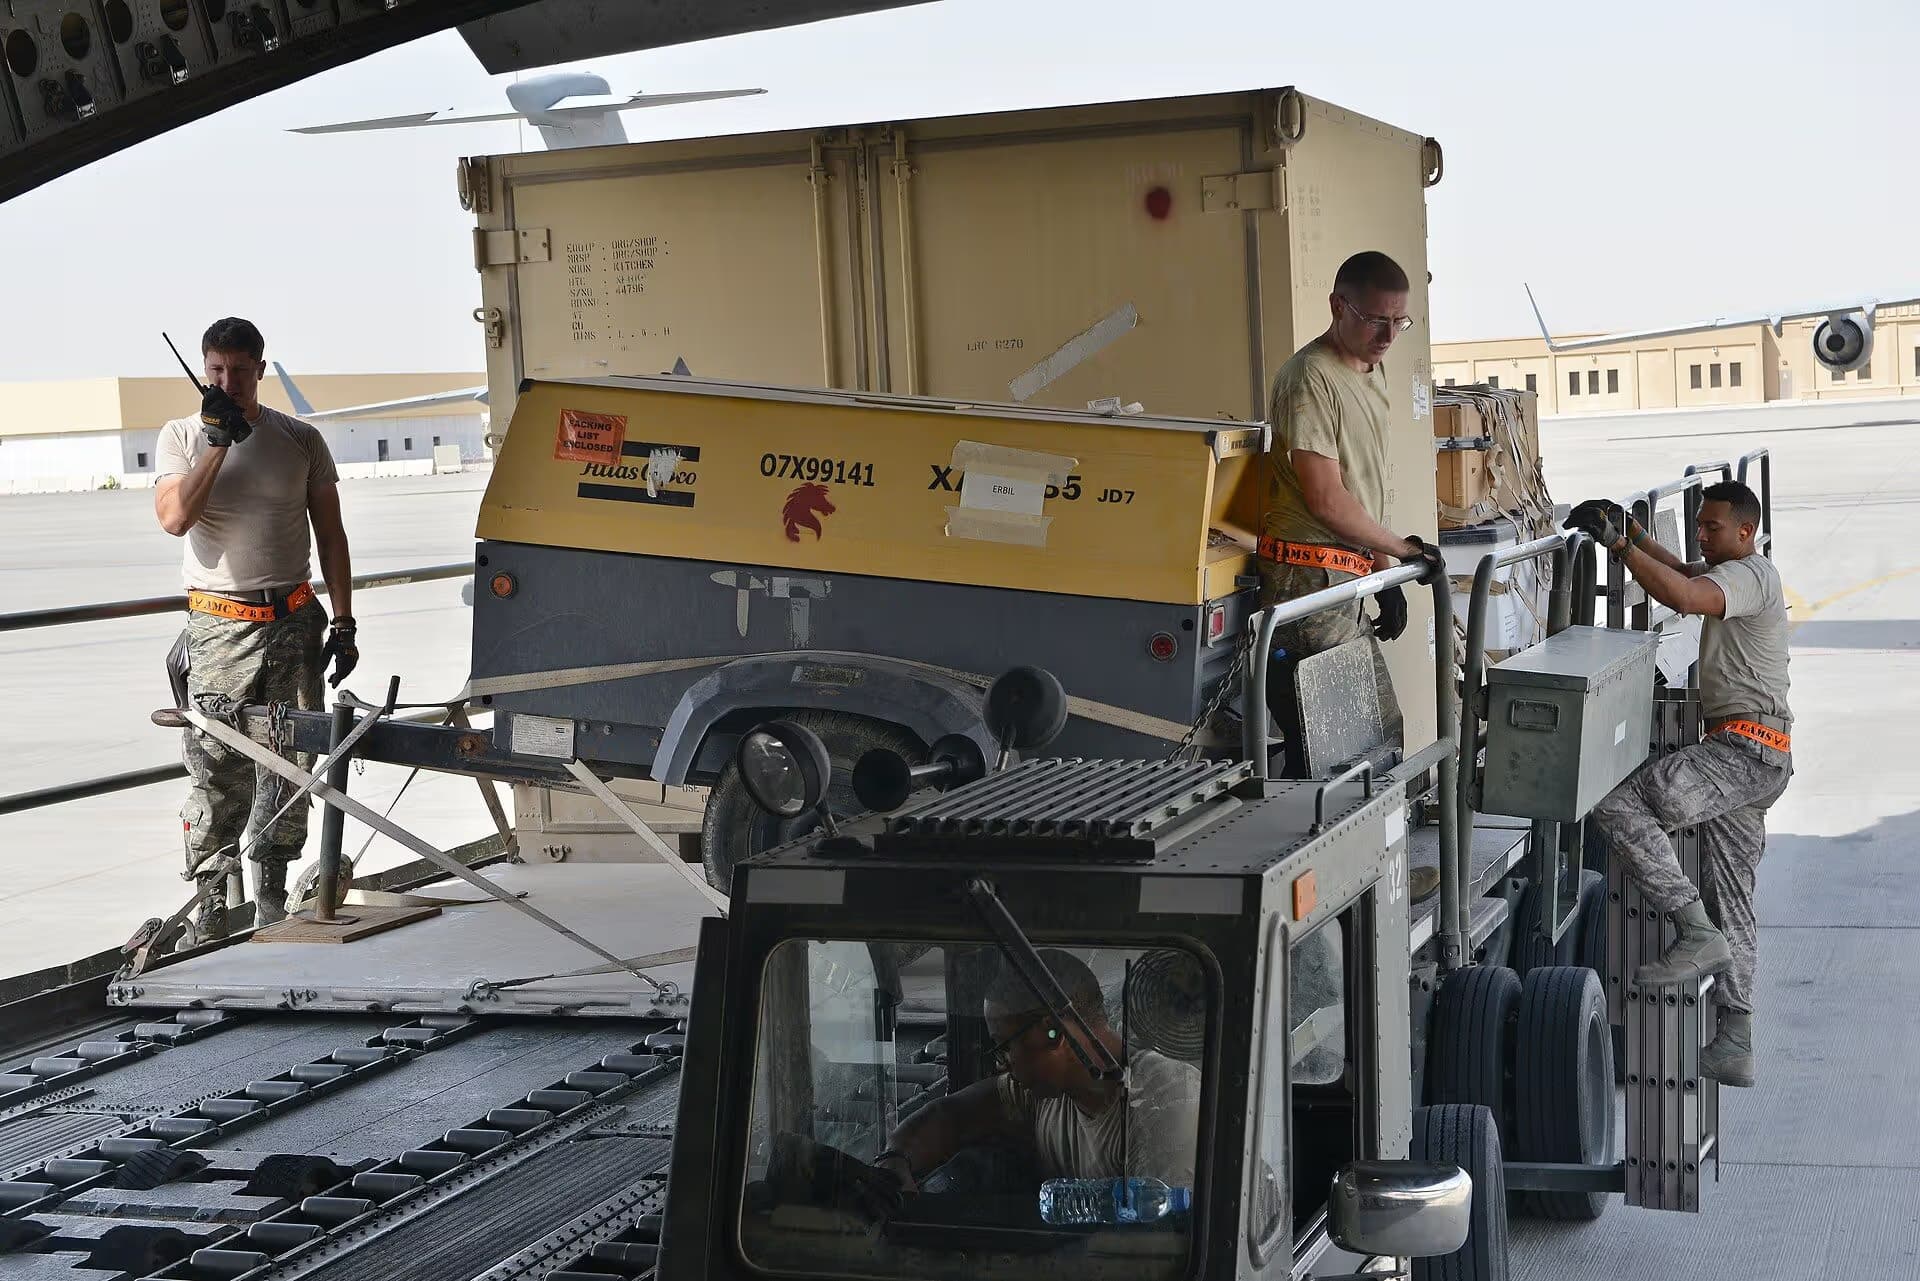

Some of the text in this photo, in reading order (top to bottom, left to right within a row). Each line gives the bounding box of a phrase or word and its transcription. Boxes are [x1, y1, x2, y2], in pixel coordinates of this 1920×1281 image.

[613, 259, 655, 272] KITCHEN
[568, 417, 613, 433] PACKING
[577, 431, 600, 442] LIST
[562, 440, 614, 454] ENCLOSED
[760, 453, 876, 488] 07X99141
[991, 484, 1017, 497] ERBIL
[1097, 488, 1136, 505] JD7
[204, 600, 232, 615] AMC
